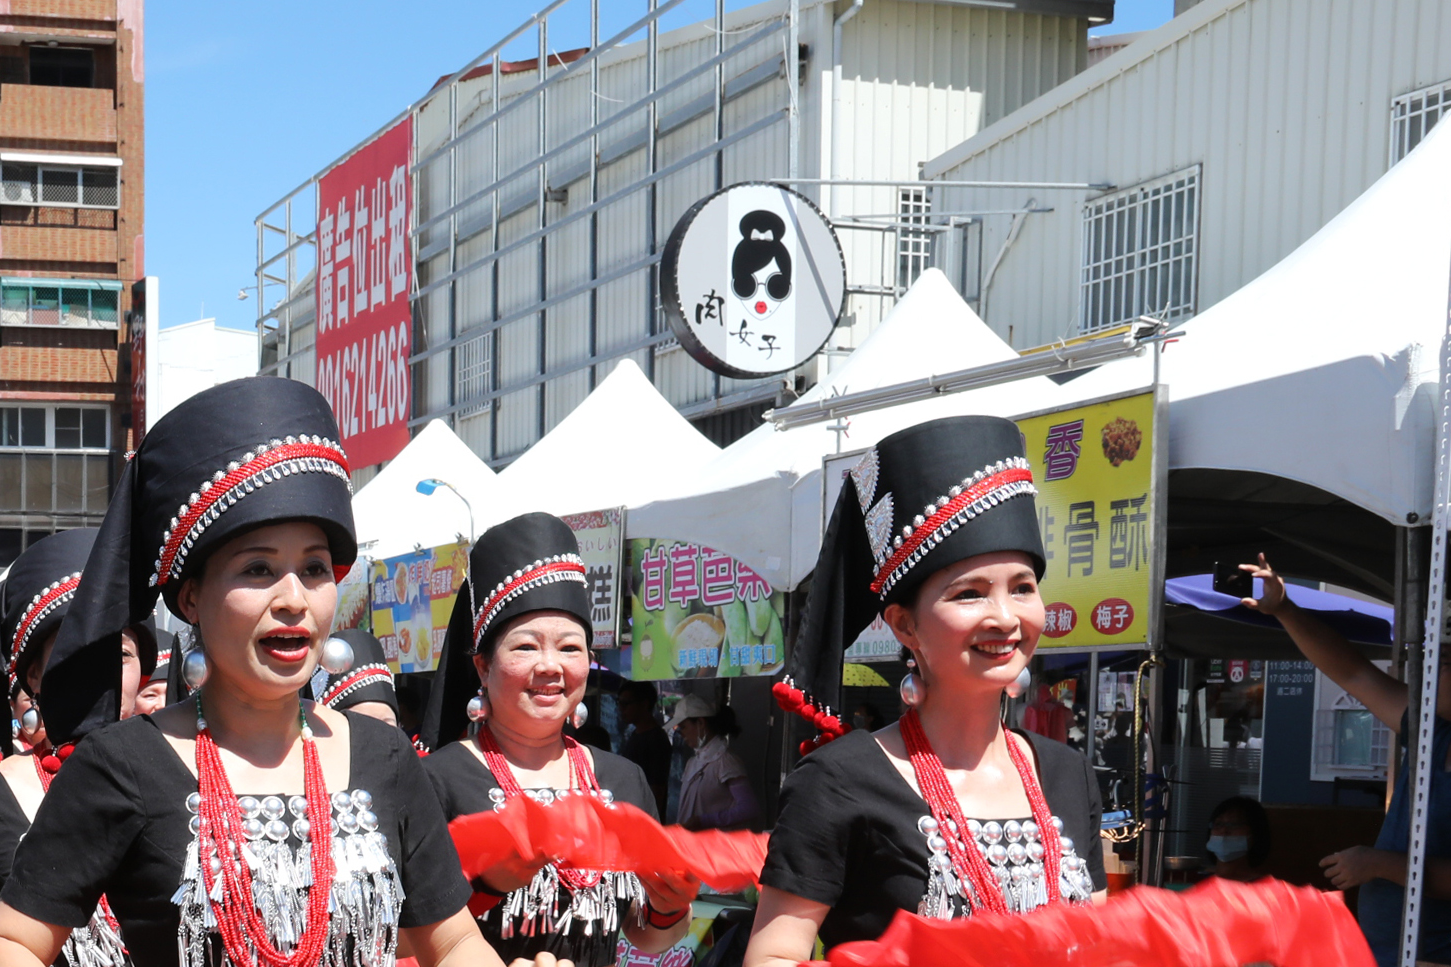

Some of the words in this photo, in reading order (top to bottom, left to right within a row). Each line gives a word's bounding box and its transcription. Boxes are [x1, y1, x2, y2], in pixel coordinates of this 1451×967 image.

[319, 165, 407, 335] 廣告位出租
[695, 289, 781, 361] 肉女子
[1096, 604, 1129, 630] 梅子
[1269, 674, 1314, 684] 17:00-20:00
